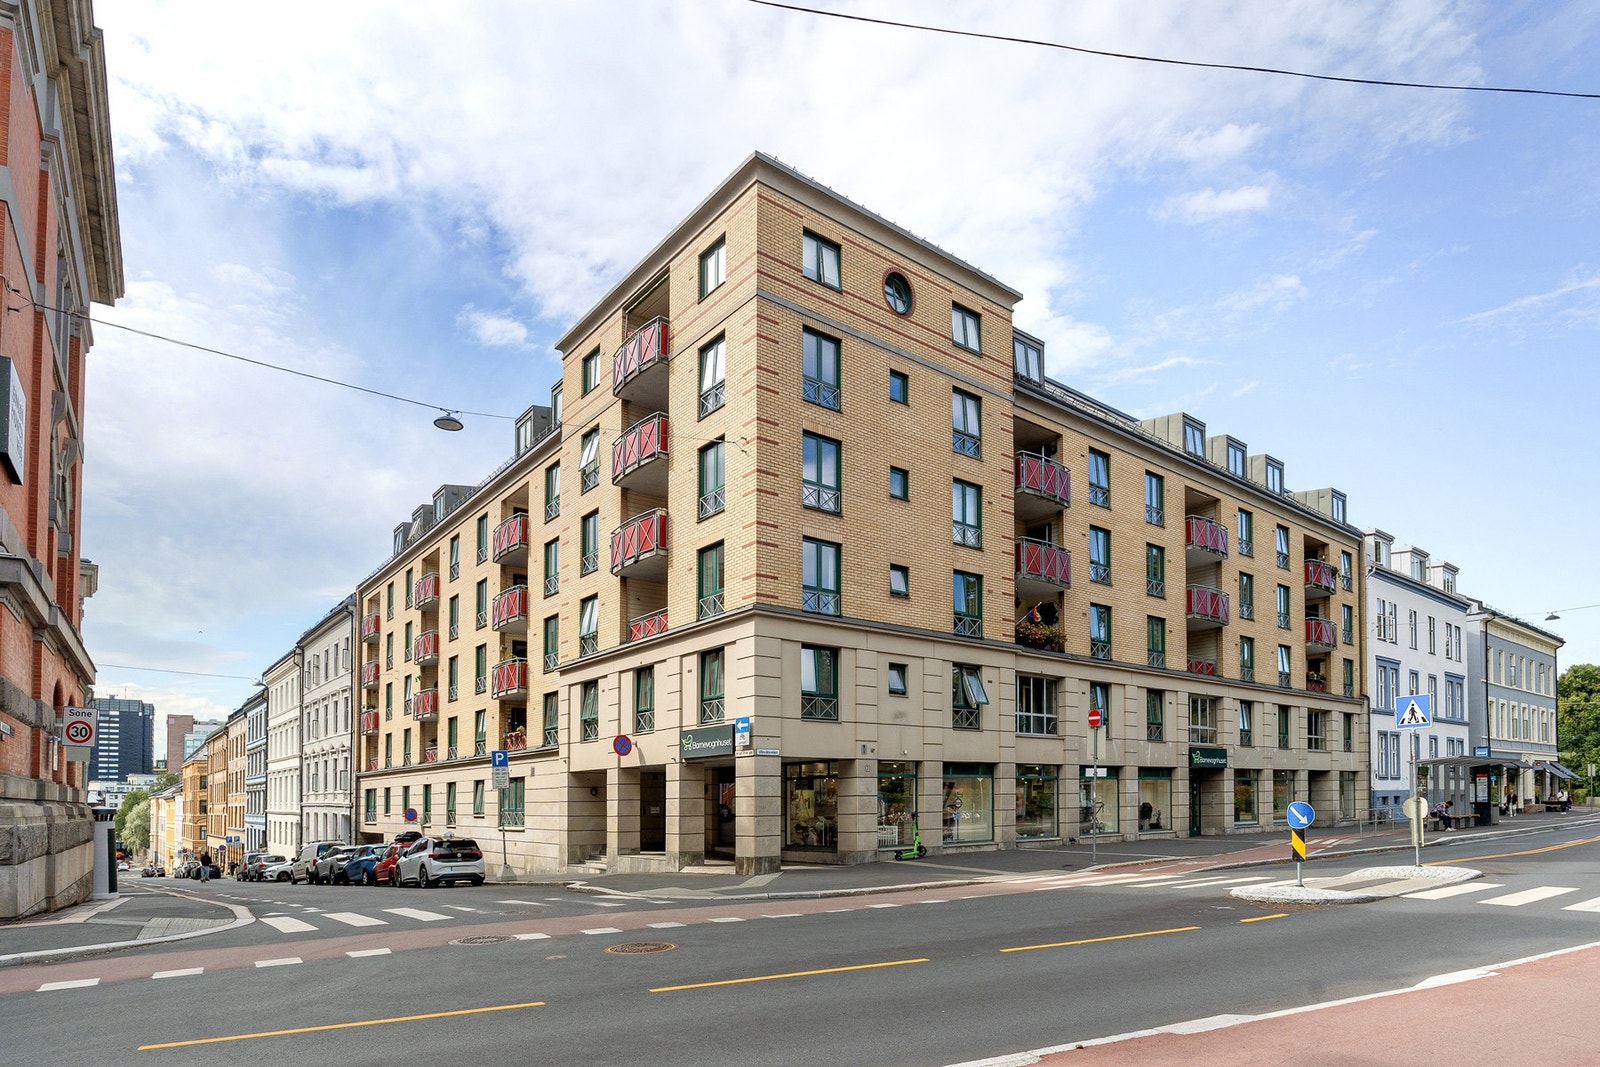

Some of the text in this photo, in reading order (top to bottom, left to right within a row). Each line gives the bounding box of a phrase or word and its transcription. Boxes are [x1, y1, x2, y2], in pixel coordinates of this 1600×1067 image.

[69, 709, 93, 718] Sone
[70, 726, 88, 738] 30
[692, 738, 733, 750] Barnevognhuset
[495, 752, 504, 766] P
